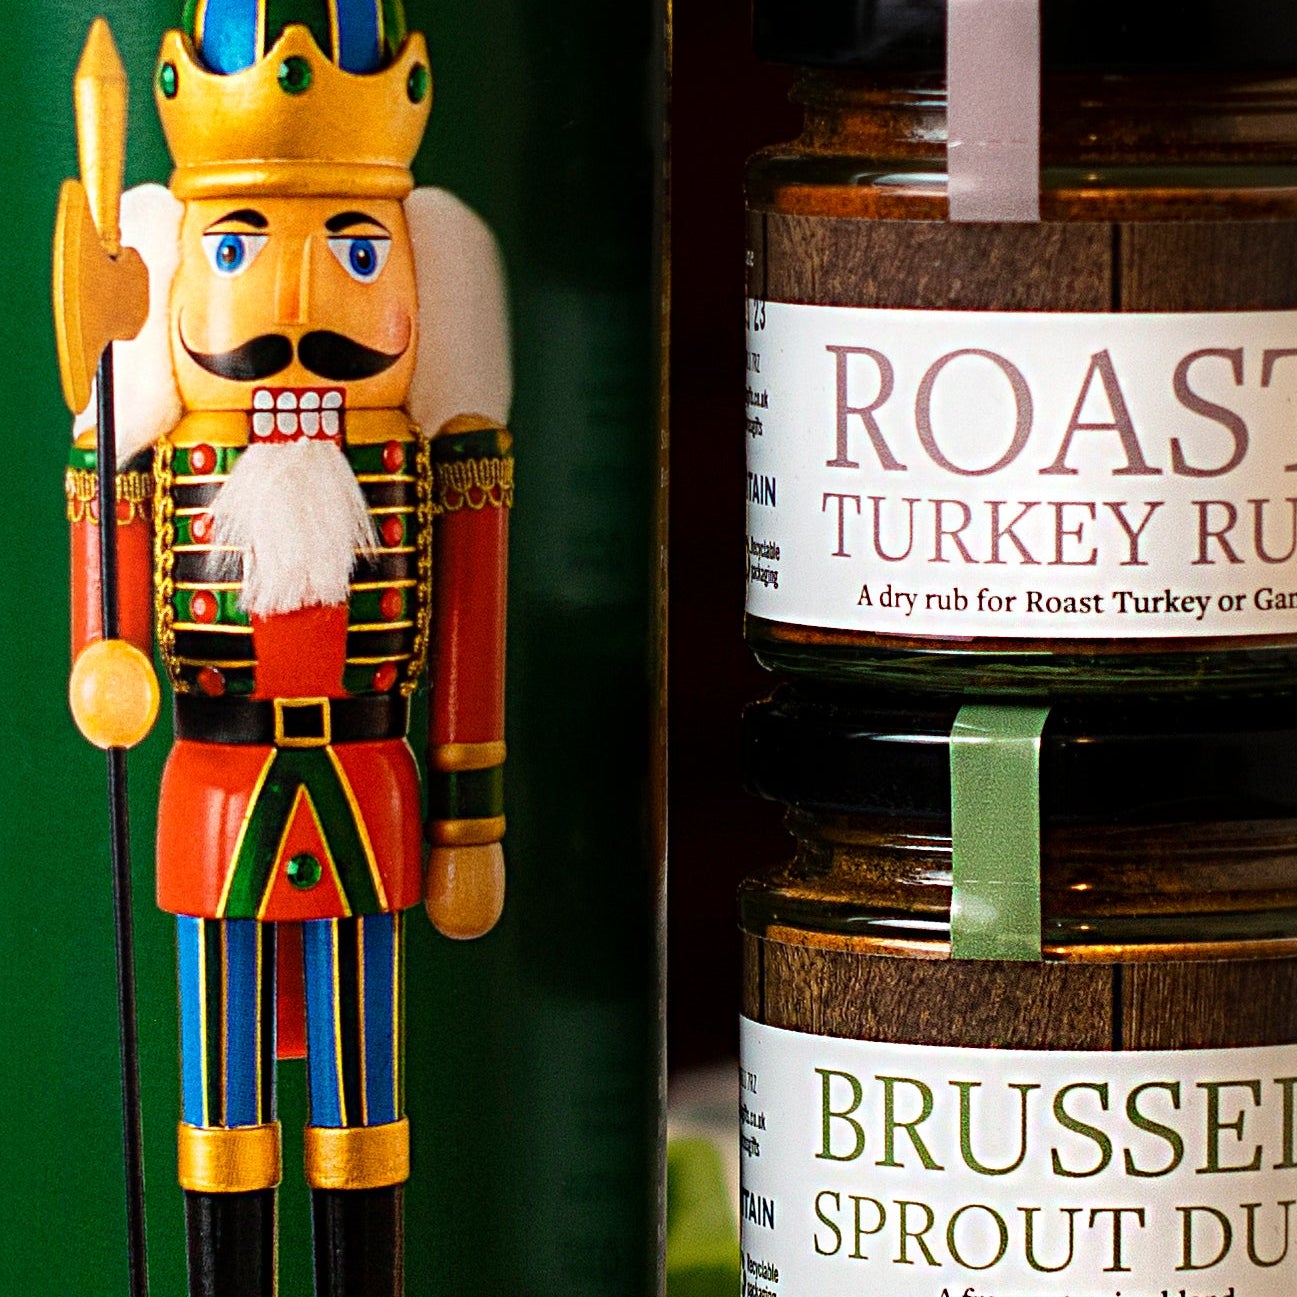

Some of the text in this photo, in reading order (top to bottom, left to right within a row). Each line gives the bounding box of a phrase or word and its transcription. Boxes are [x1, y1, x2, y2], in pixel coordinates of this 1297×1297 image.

[822, 493, 1165, 566] TURKEY
[858, 585, 872, 606] A
[879, 584, 917, 618] dry
[926, 588, 968, 610] rub
[977, 588, 1016, 612] for
[1026, 591, 1103, 613] Roast
[1113, 589, 1211, 620] Turkey
[1218, 595, 1246, 611] or
[814, 1191, 1145, 1273] SPROUT
